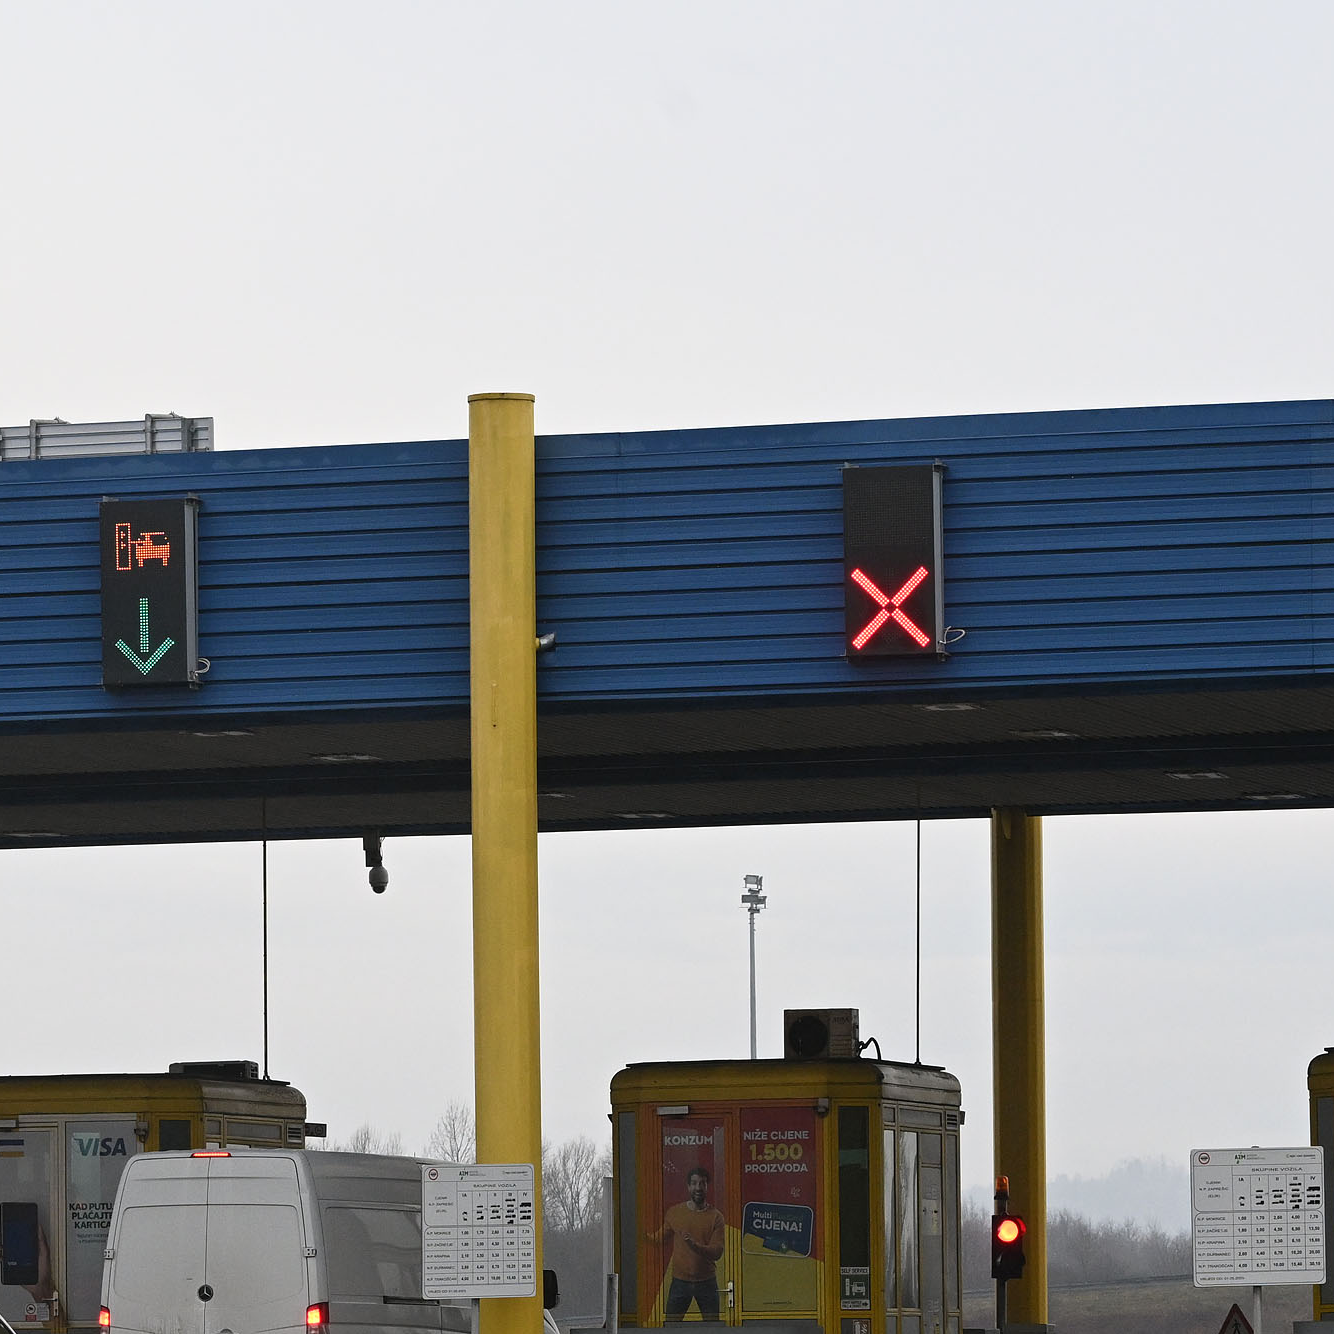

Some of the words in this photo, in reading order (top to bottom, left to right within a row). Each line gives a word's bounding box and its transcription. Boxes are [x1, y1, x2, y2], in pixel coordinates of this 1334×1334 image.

[743, 1129, 768, 1140] NIŽE
[770, 1131, 810, 1140] CIJENE
[664, 1135, 713, 1146] KONZUM
[74, 1138, 127, 1156] VISA
[749, 1143, 803, 1161] 1.500
[744, 1163, 808, 1173] PROIZVODA
[69, 1203, 87, 1211] KAD
[74, 1221, 111, 1229] KARTICA
[752, 1218, 803, 1232] CIJENA!
